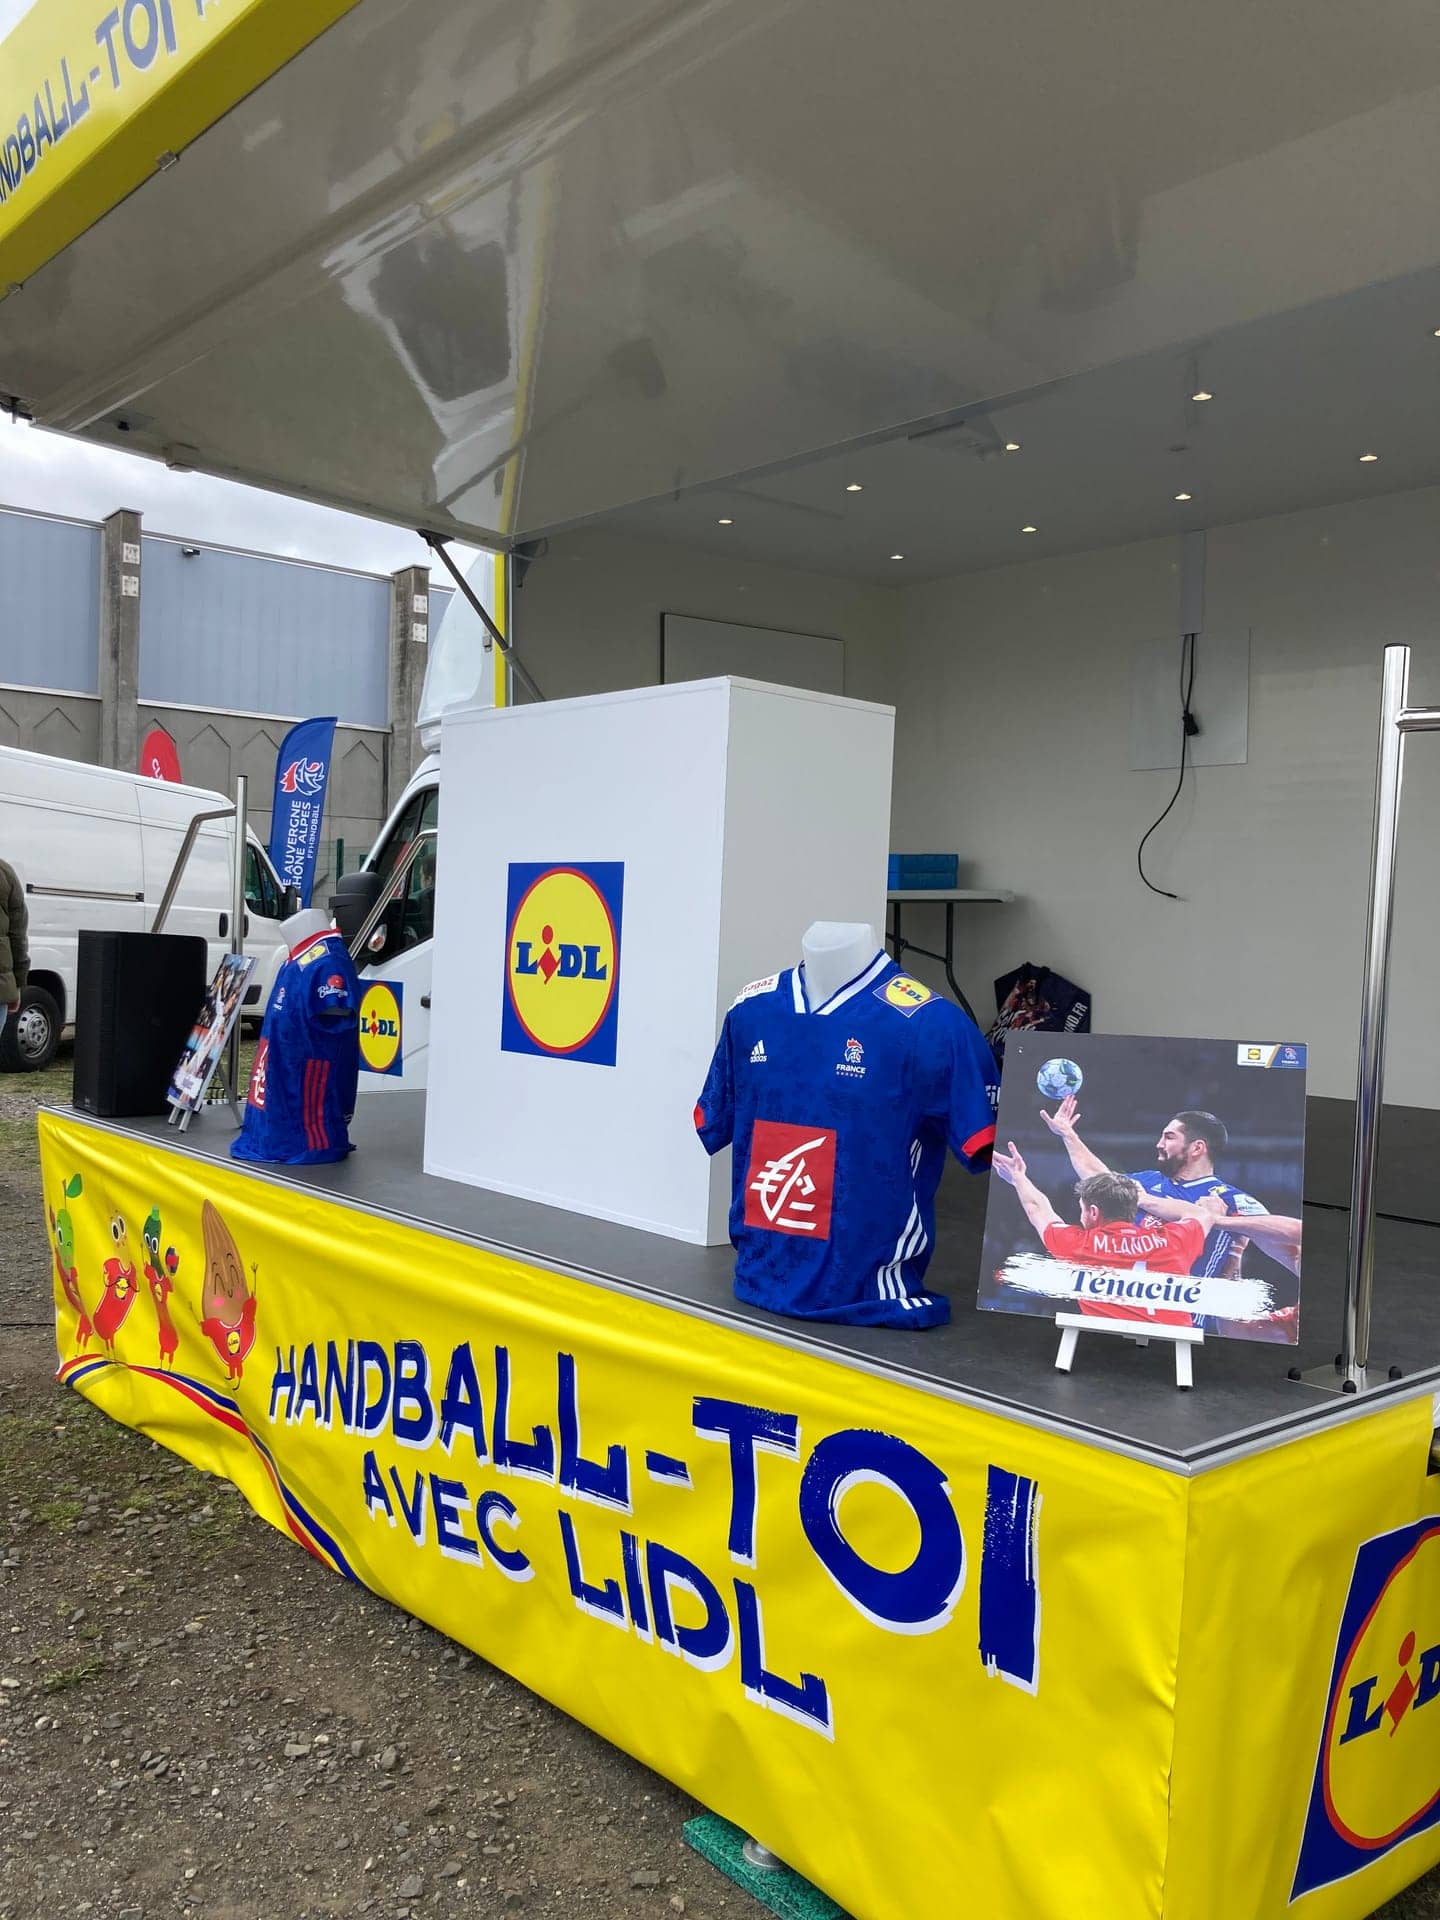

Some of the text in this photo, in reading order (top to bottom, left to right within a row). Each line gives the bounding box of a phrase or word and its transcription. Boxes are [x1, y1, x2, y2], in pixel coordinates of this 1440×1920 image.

[0, 0, 176, 200] NDBALL-TOI
[284, 800, 301, 874] AUVERGNE
[292, 801, 311, 889] HÔNE ALPES
[1071, 1269, 1201, 1303] Ténacité
[269, 1339, 1041, 1695] HANDBALL-TOI
[363, 1450, 834, 1741] AVEC LIDL
